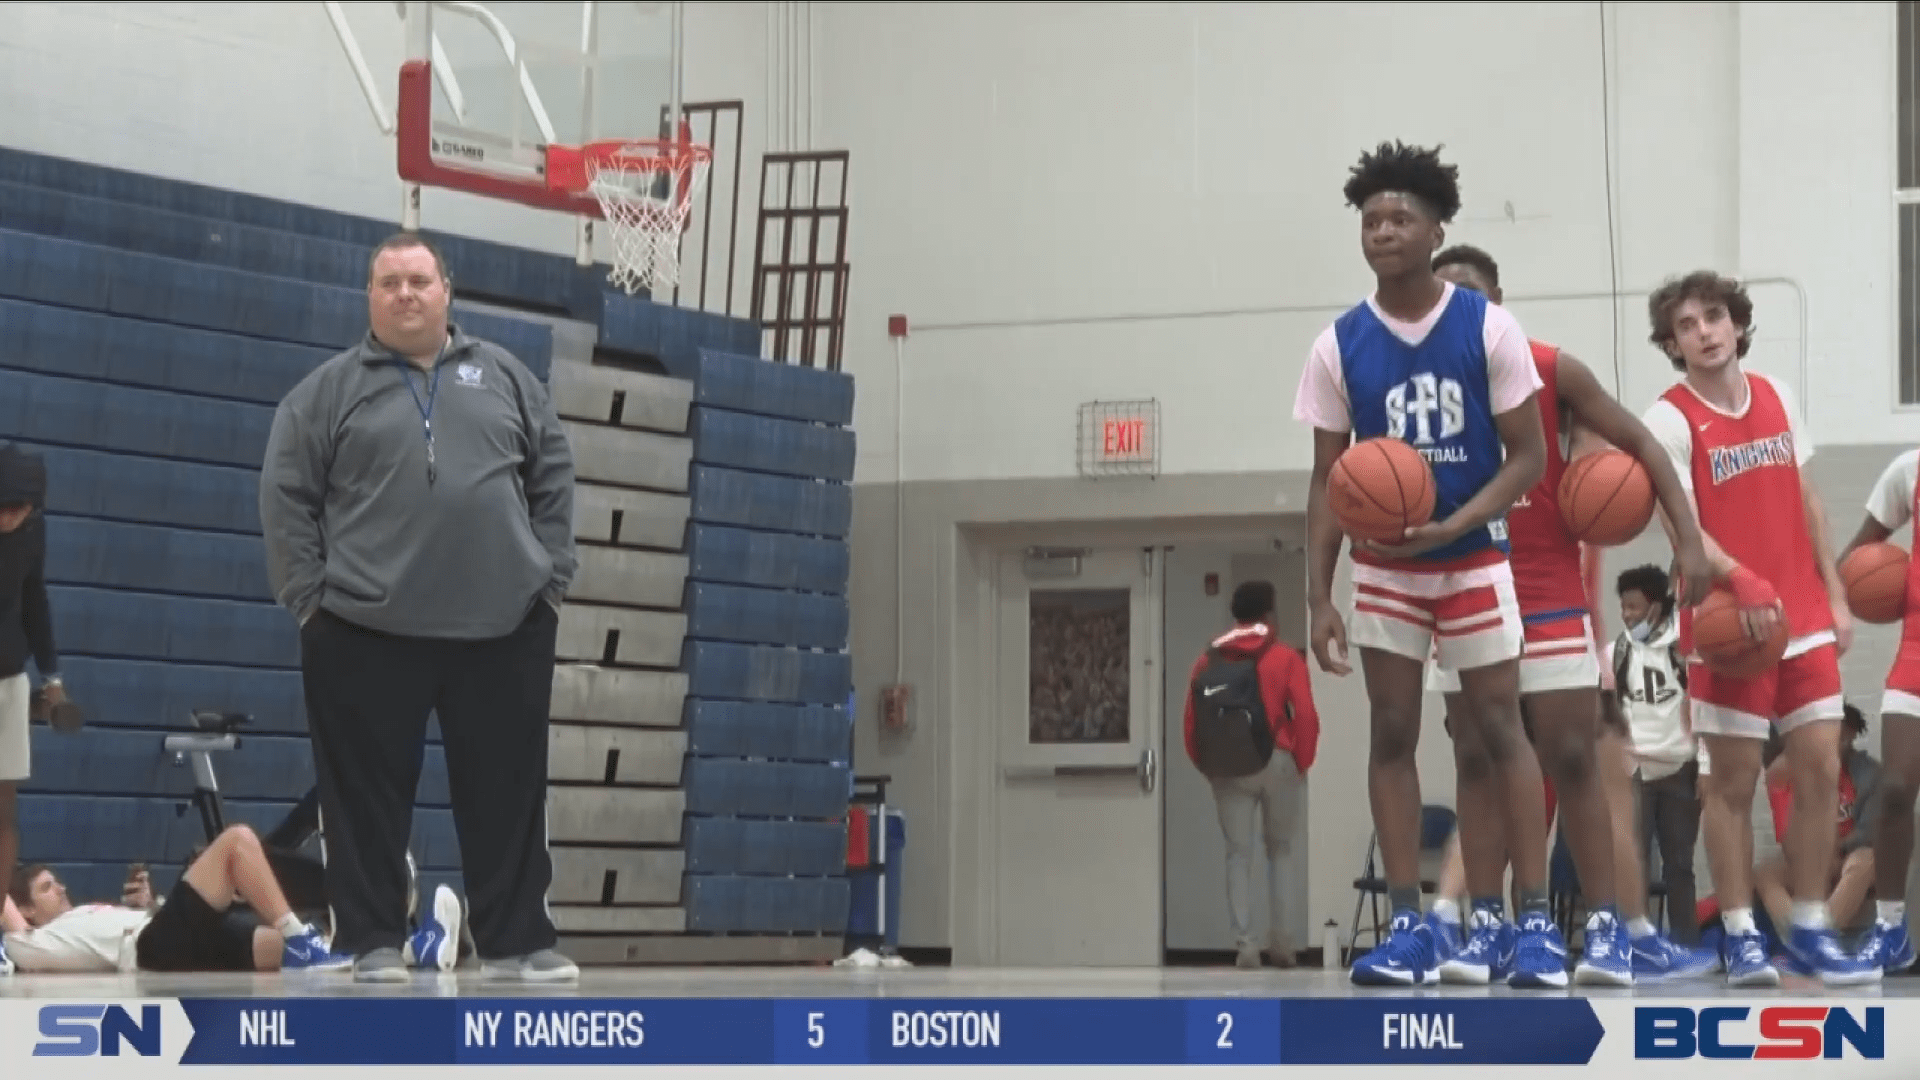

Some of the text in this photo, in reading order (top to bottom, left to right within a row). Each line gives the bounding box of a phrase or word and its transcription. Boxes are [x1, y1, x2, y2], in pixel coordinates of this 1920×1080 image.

[1104, 420, 1144, 454] EXIT
[1417, 447, 1468, 462] TBALL
[1707, 432, 1794, 486] KNIGHTS
